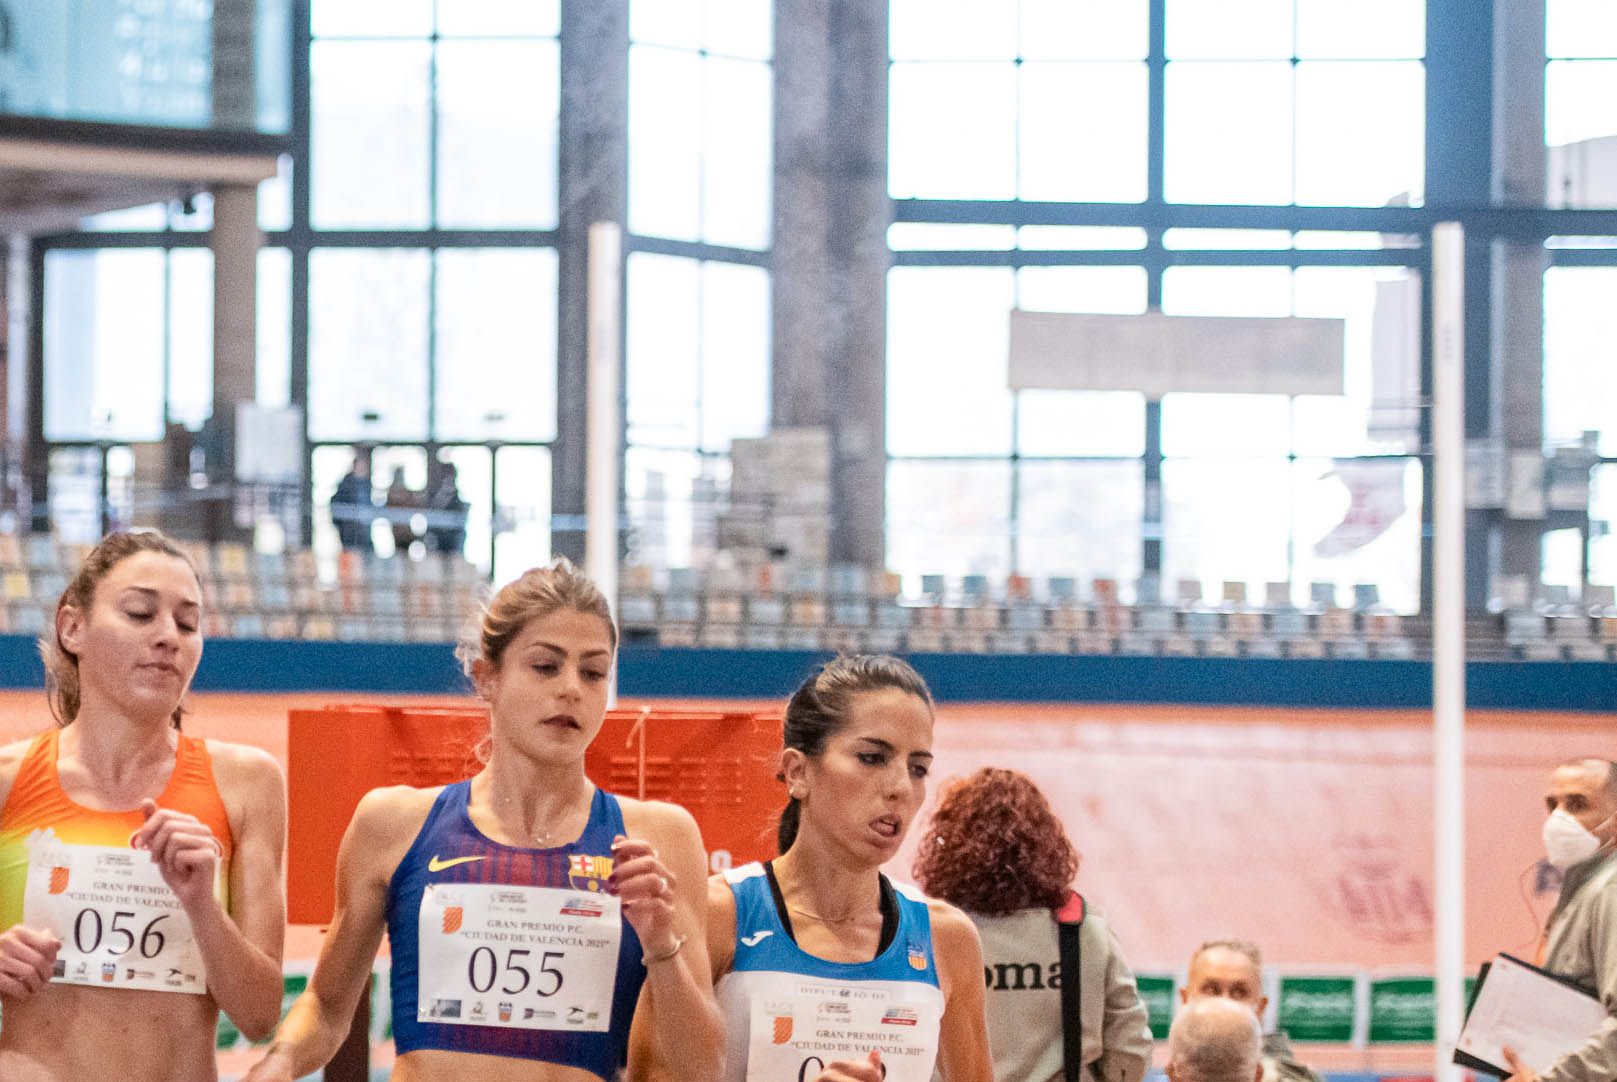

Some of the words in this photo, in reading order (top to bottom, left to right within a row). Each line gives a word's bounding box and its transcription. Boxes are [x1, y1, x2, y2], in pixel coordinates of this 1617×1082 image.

[93, 881, 125, 892] GRAN
[127, 884, 170, 896] PREMIO
[116, 895, 132, 904] DE
[487, 920, 519, 929] GRAN
[521, 922, 565, 933] PREMIO
[74, 908, 171, 959] 056
[510, 934, 526, 943] DE
[528, 935, 583, 946] VALENCIA
[468, 946, 565, 997] 055
[816, 1029, 844, 1039] GRAN
[846, 1031, 887, 1041] PREMIO
[837, 1044, 851, 1053] DE
[853, 1044, 903, 1055] VALENCIA
